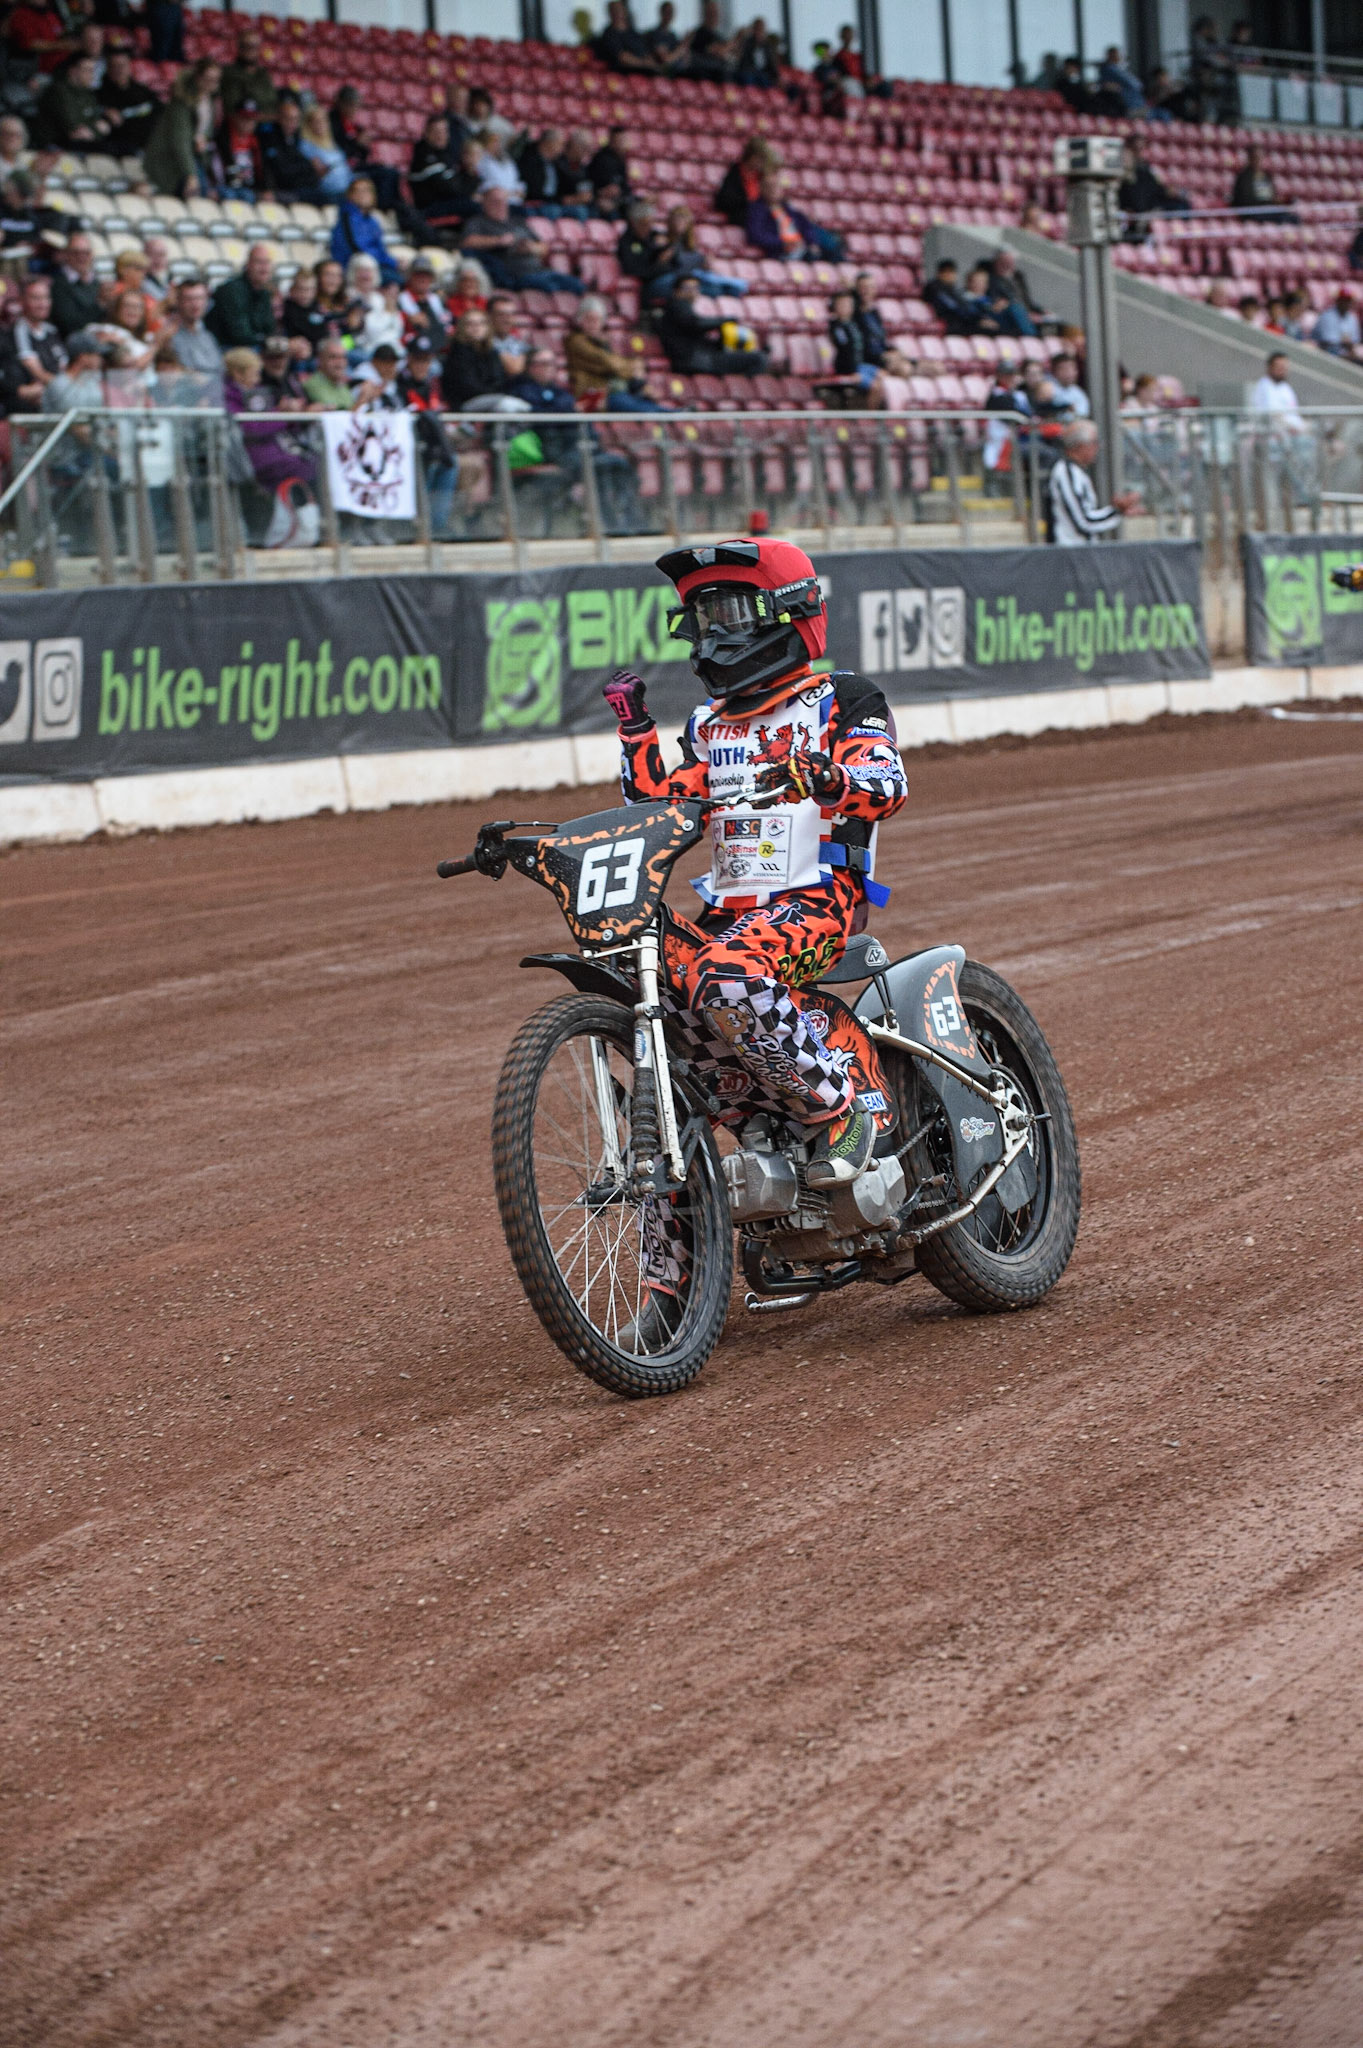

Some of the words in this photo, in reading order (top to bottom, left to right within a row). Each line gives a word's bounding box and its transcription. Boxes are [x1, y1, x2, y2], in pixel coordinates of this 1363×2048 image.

[975, 590, 1198, 671] bike-right.com
[98, 638, 442, 741] bike-right.com
[726, 820, 760, 835] NSSC
[577, 837, 645, 915] 63
[930, 995, 961, 1037] 63
